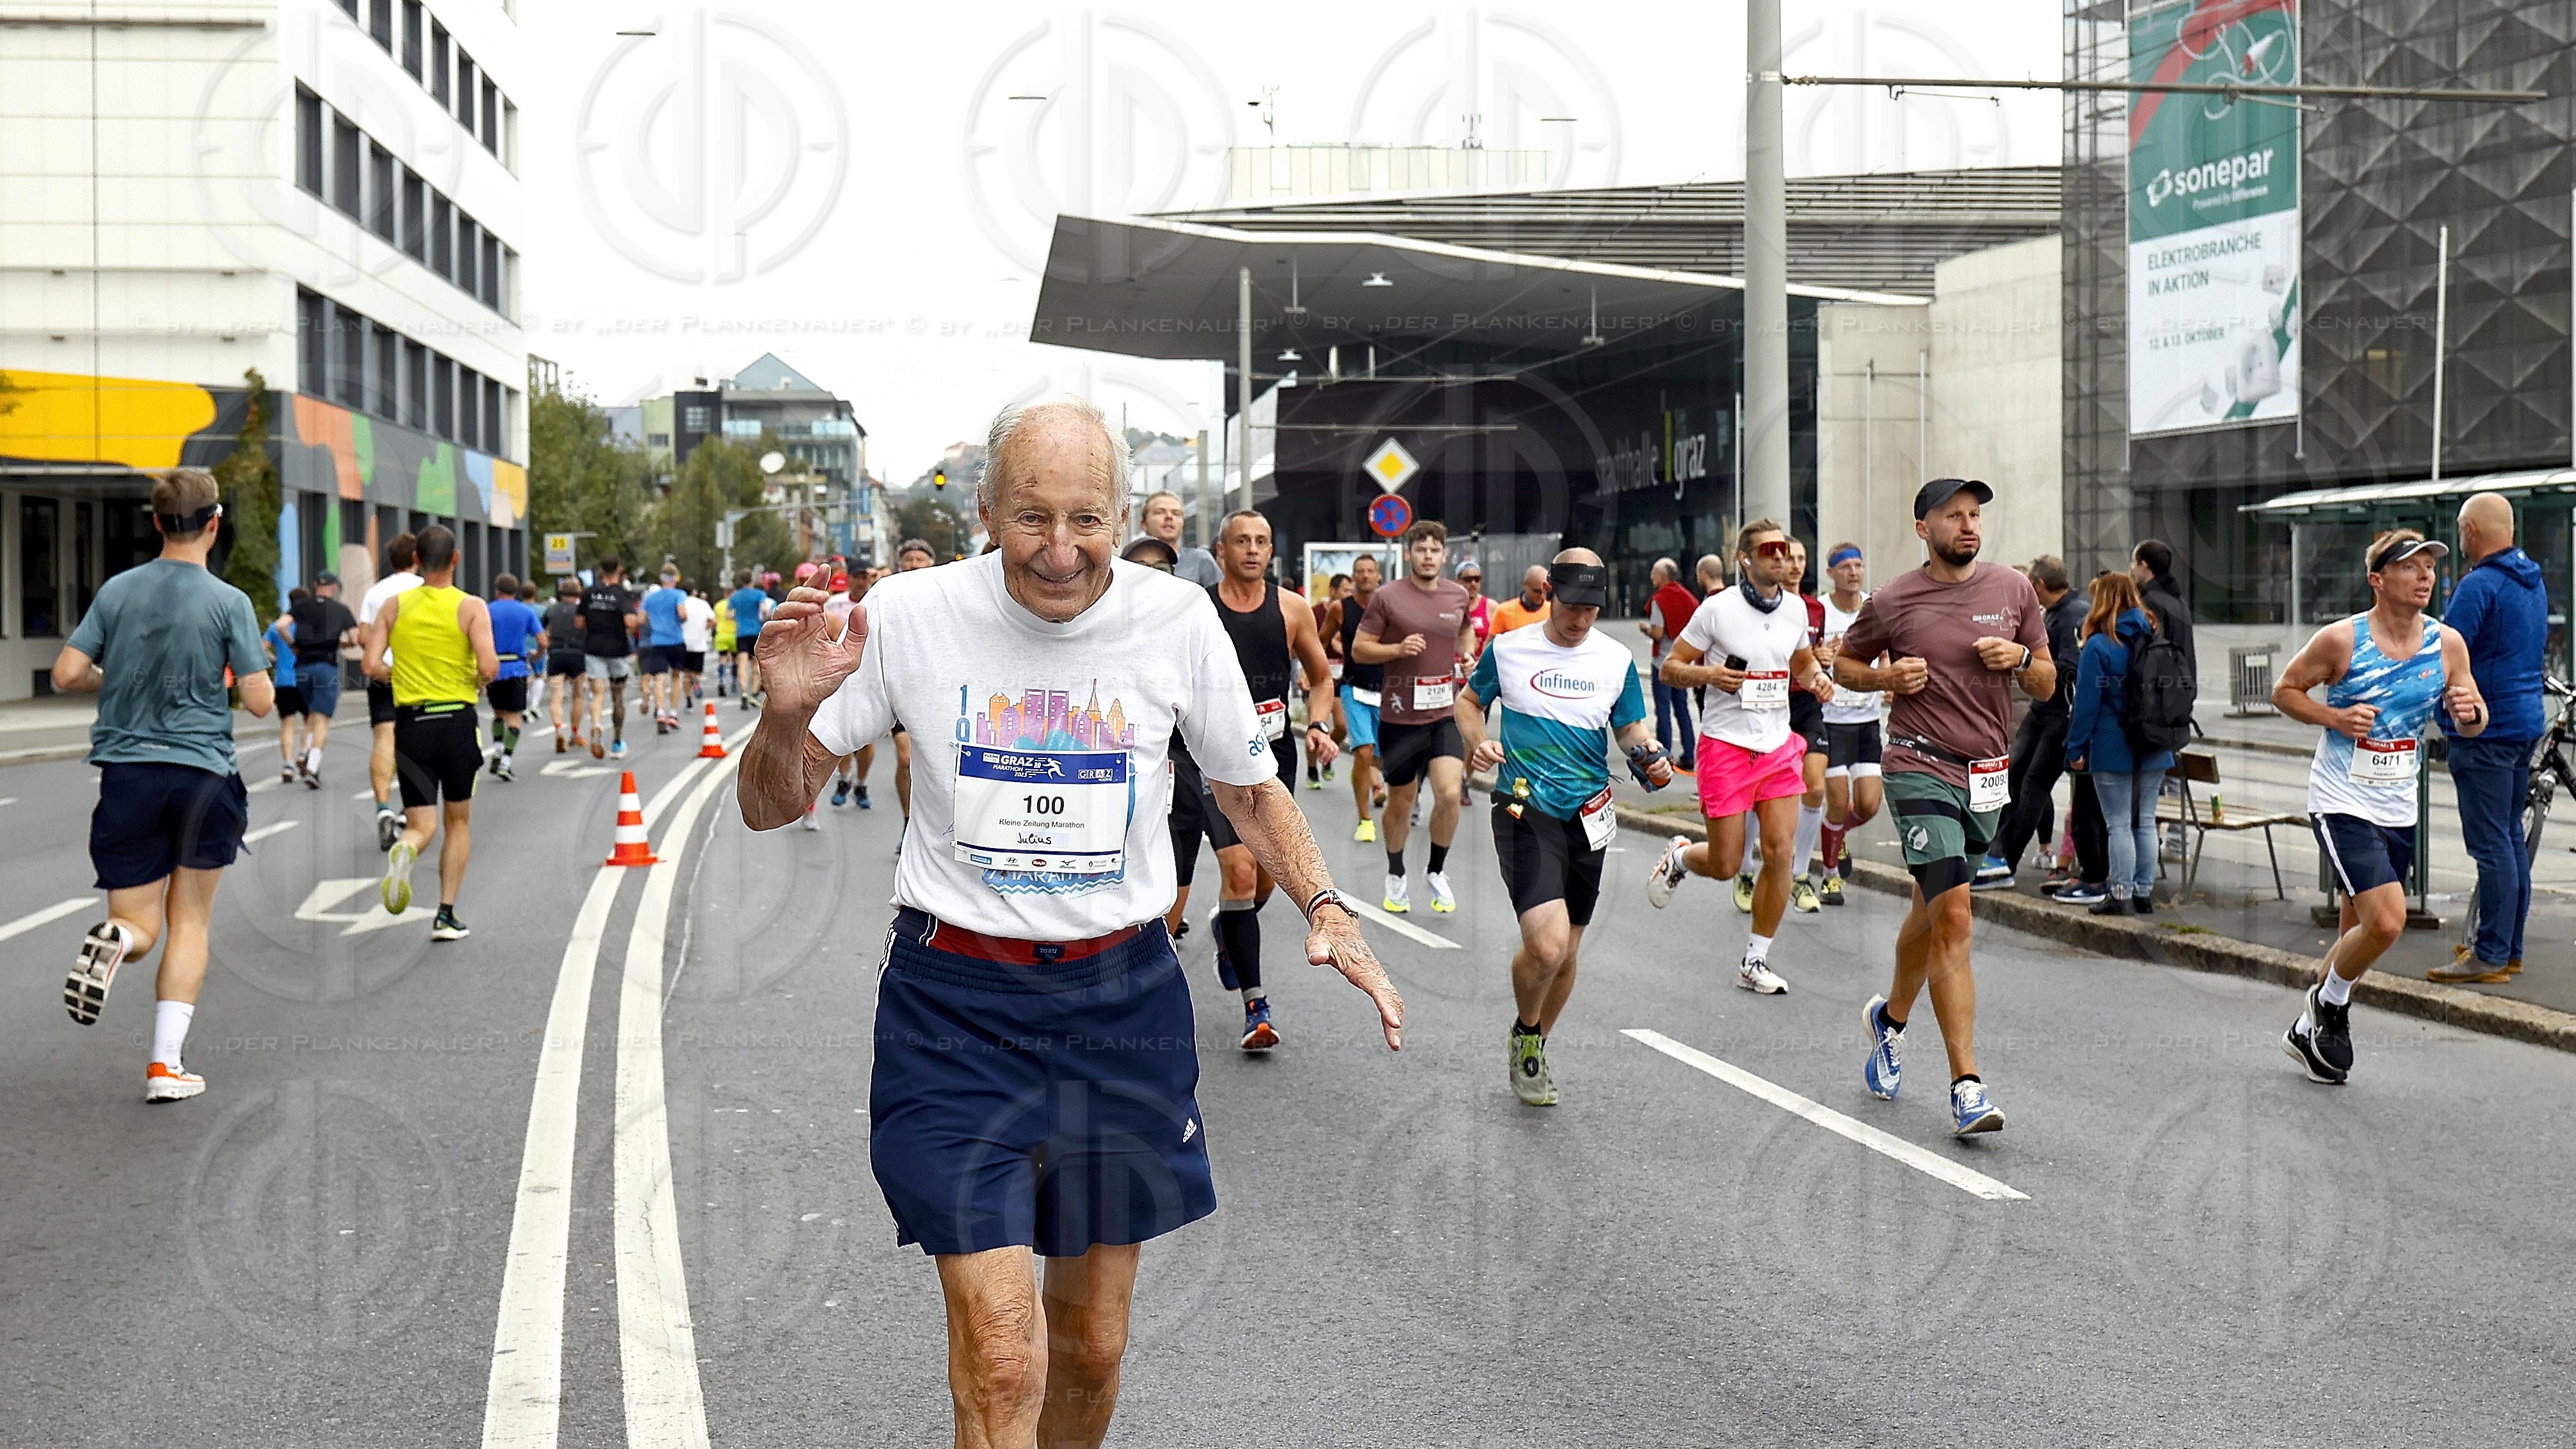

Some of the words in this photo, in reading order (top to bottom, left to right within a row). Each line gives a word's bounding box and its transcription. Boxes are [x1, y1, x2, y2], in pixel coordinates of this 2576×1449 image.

[2175, 148, 2273, 196] sonepar
[2148, 231, 2262, 270] ELEKTROBRANCHE
[2148, 278, 2160, 296] IN
[2163, 269, 2209, 294] AKTION
[1674, 433, 1706, 501] graz
[1540, 669, 1595, 692] infineon
[1756, 682, 1776, 691] 4284
[1001, 755, 1034, 767] GRAZ
[2372, 755, 2399, 765] 6471
[1079, 769, 1113, 779] GRAZ
[1023, 795, 1065, 815] 100
[1023, 820, 1050, 829] Zeitung
[1017, 832, 1052, 845] Julius
